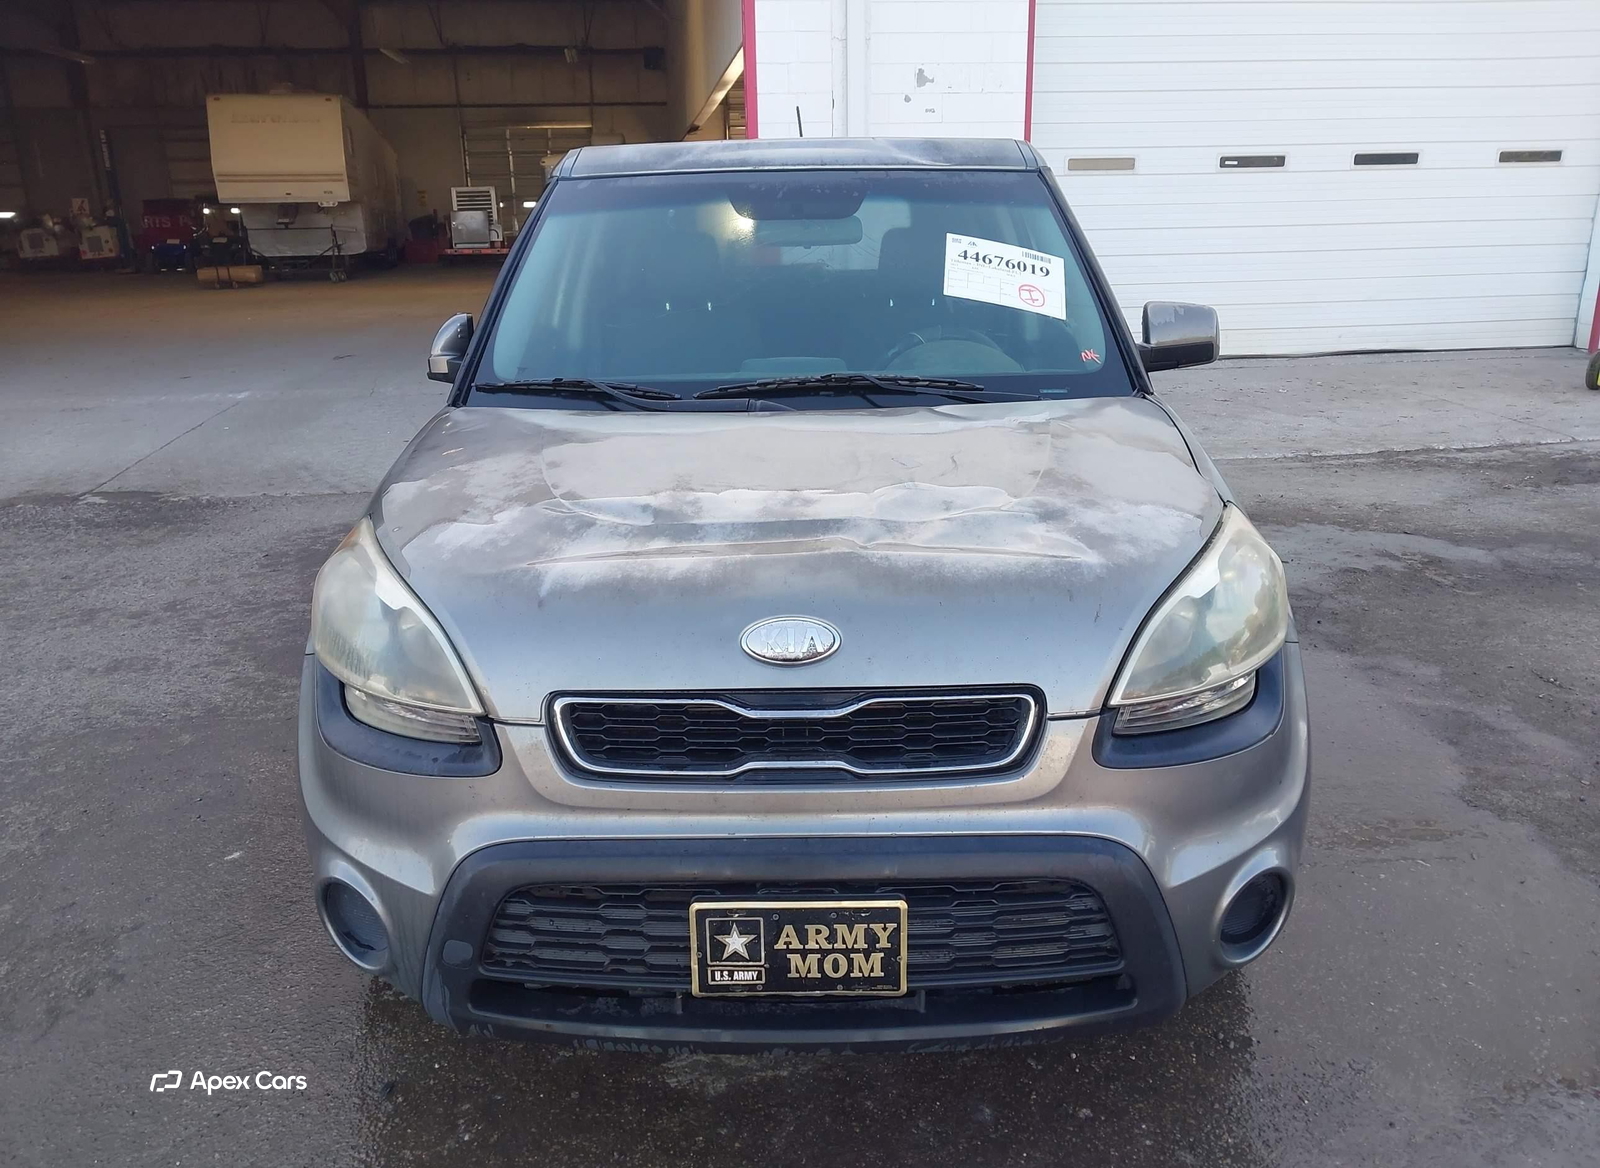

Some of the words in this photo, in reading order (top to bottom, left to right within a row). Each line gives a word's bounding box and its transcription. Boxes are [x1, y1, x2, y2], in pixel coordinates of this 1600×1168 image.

[957, 249, 1050, 278] 44676019
[760, 626, 825, 653] KIA
[773, 923, 898, 950] ARMY
[714, 970, 732, 981] U.S.
[733, 970, 758, 981] ARMY
[786, 952, 885, 978] MOM
